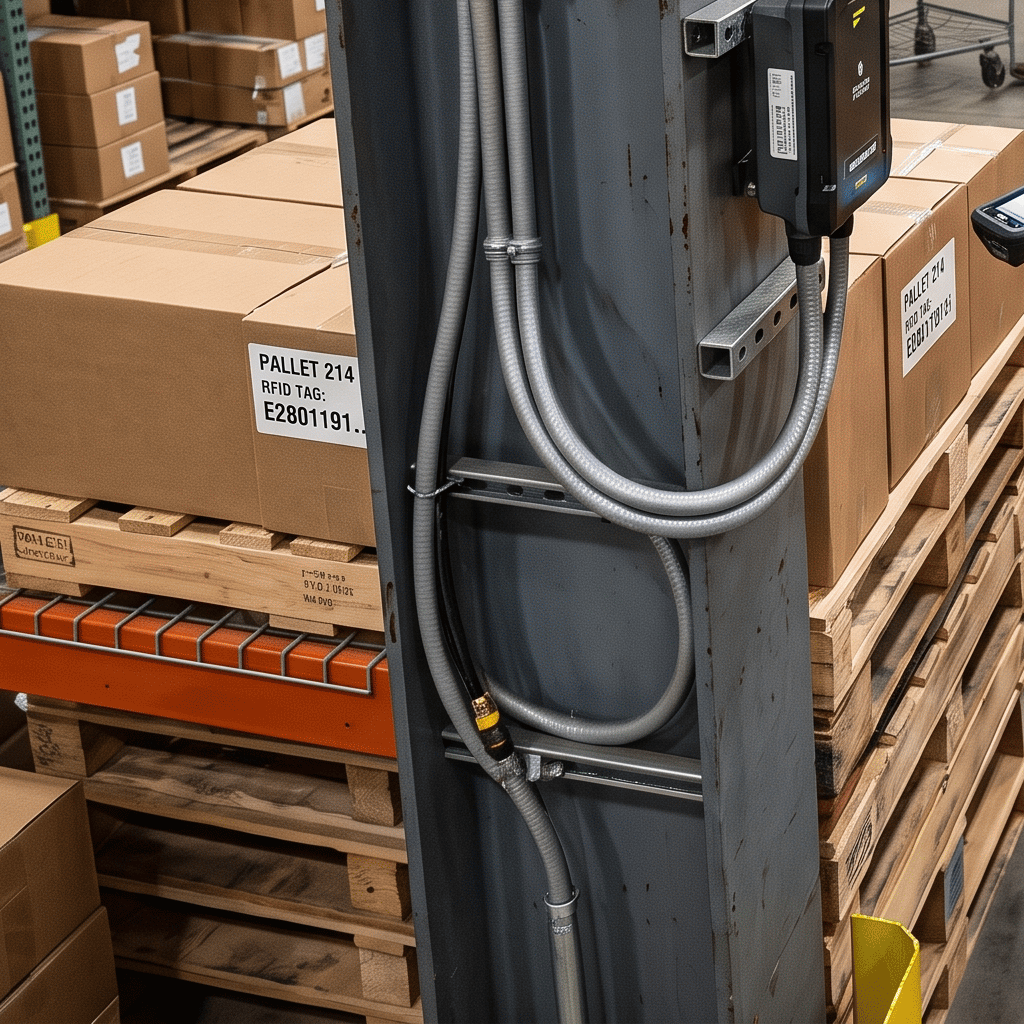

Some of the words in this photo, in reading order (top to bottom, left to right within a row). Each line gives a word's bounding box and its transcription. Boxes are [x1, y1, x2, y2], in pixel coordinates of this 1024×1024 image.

[904, 271, 929, 313] PALLET
[259, 353, 319, 378] PALLET
[324, 362, 355, 383] 214
[261, 379, 291, 396] RFID
[295, 384, 326, 402] TAG:
